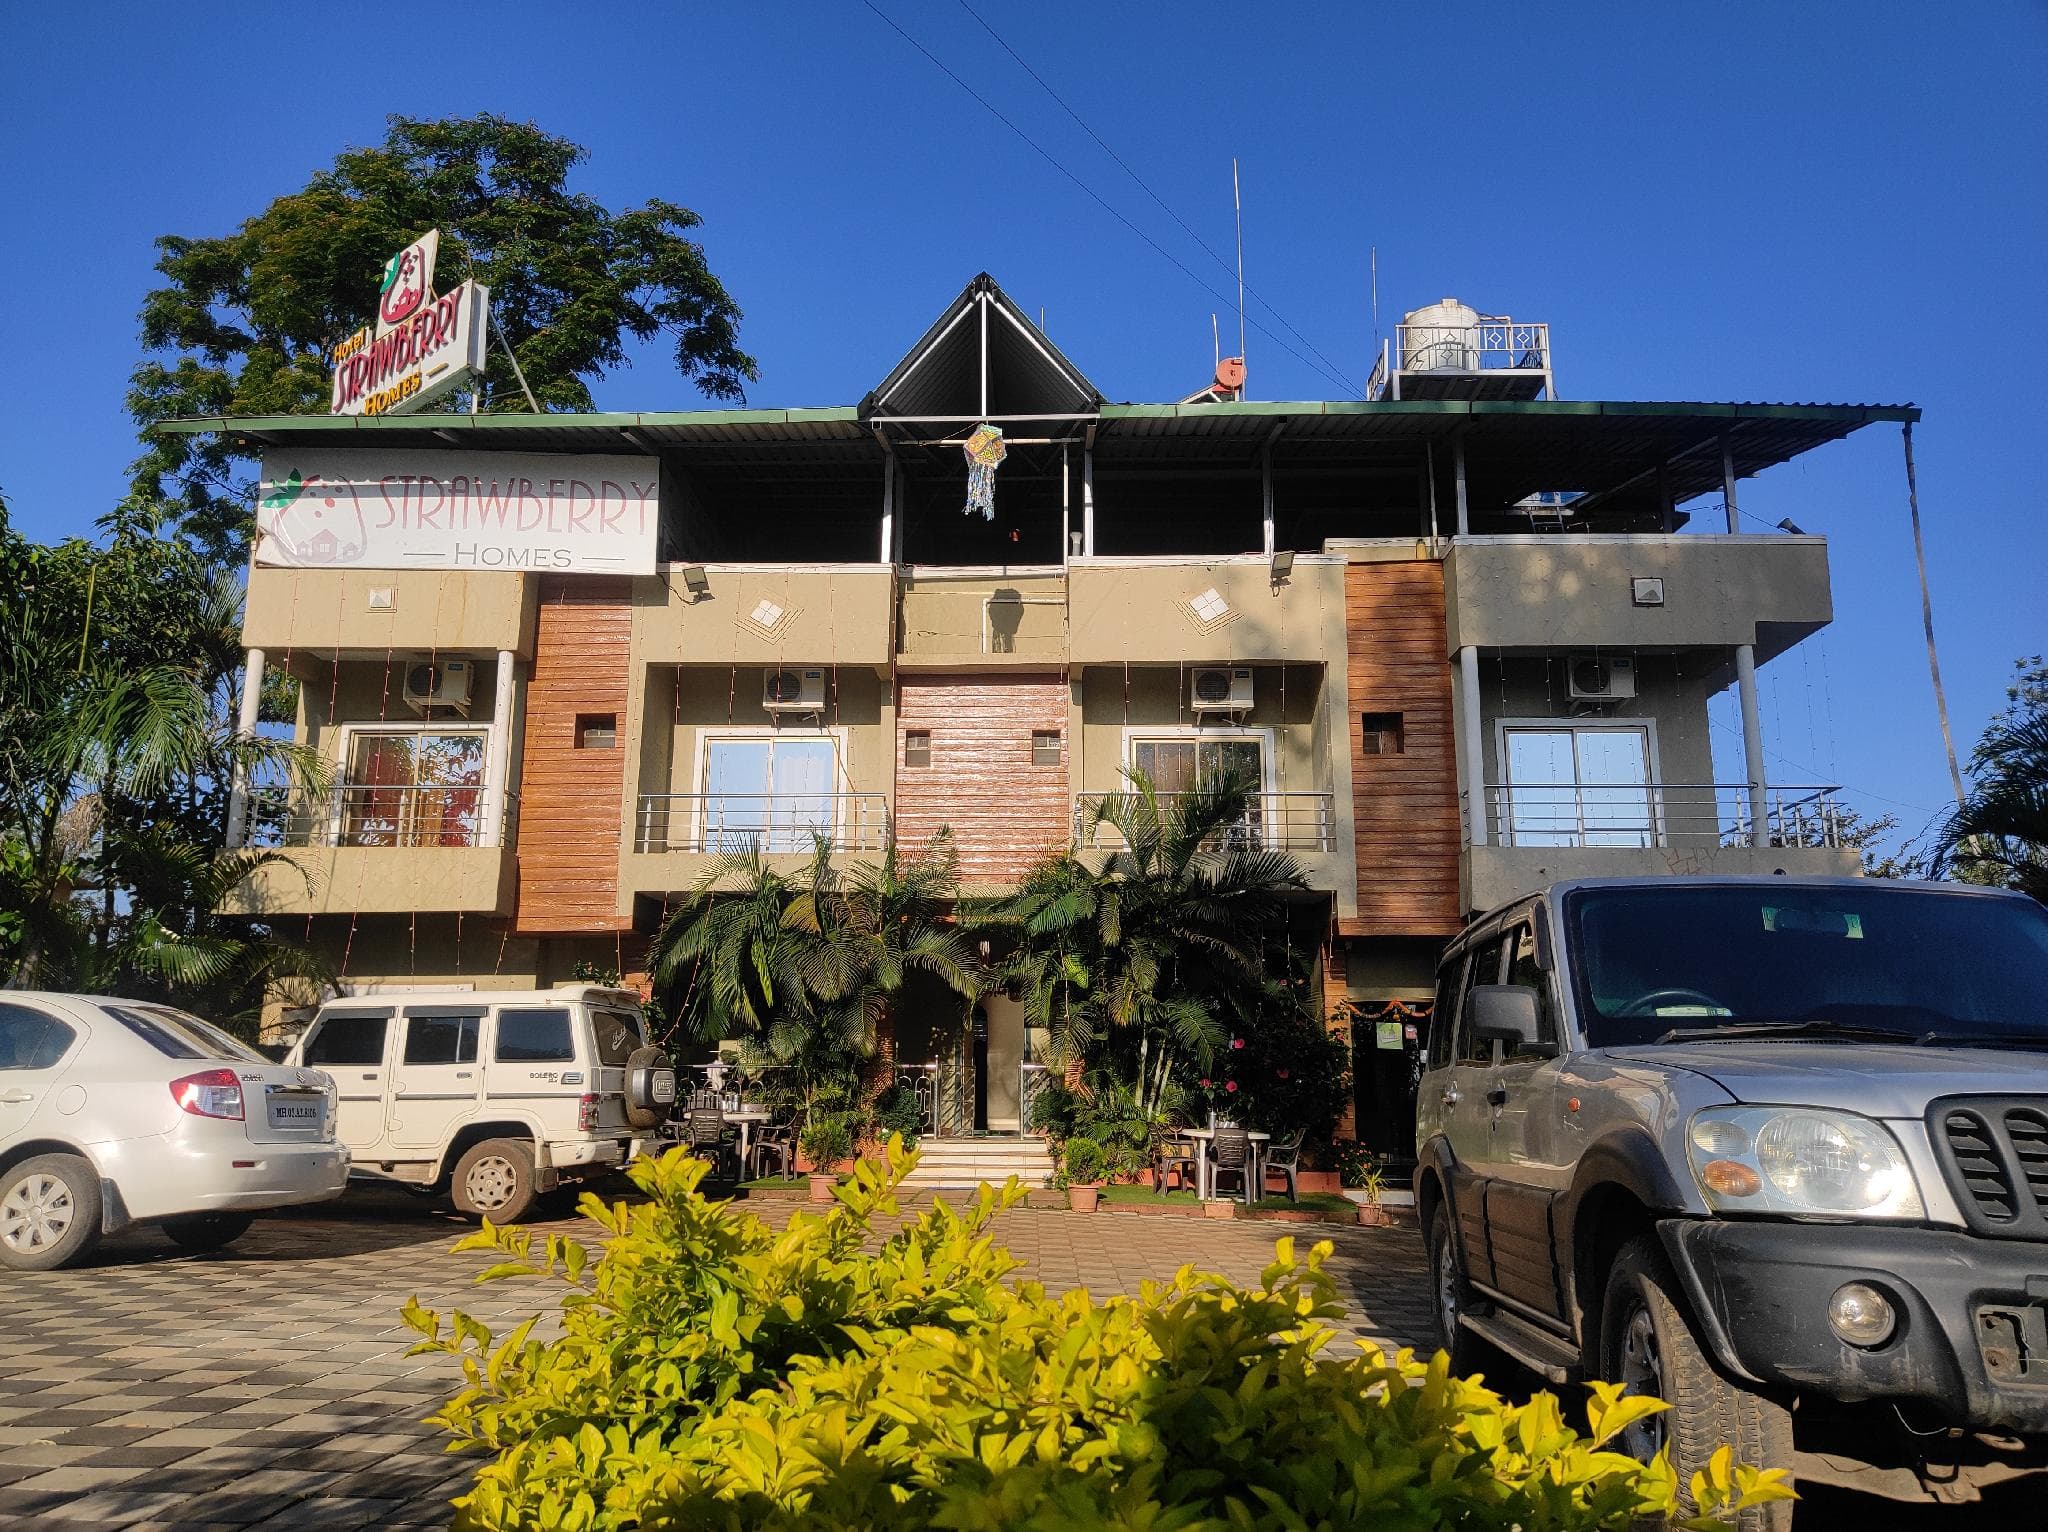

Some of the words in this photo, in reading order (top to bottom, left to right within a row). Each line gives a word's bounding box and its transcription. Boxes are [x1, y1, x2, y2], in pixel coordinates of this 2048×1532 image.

[333, 285, 465, 415] STRAWBERRY
[334, 326, 366, 363] Hotel
[364, 370, 422, 416] HOMES
[375, 475, 657, 536] STRAWBERRY
